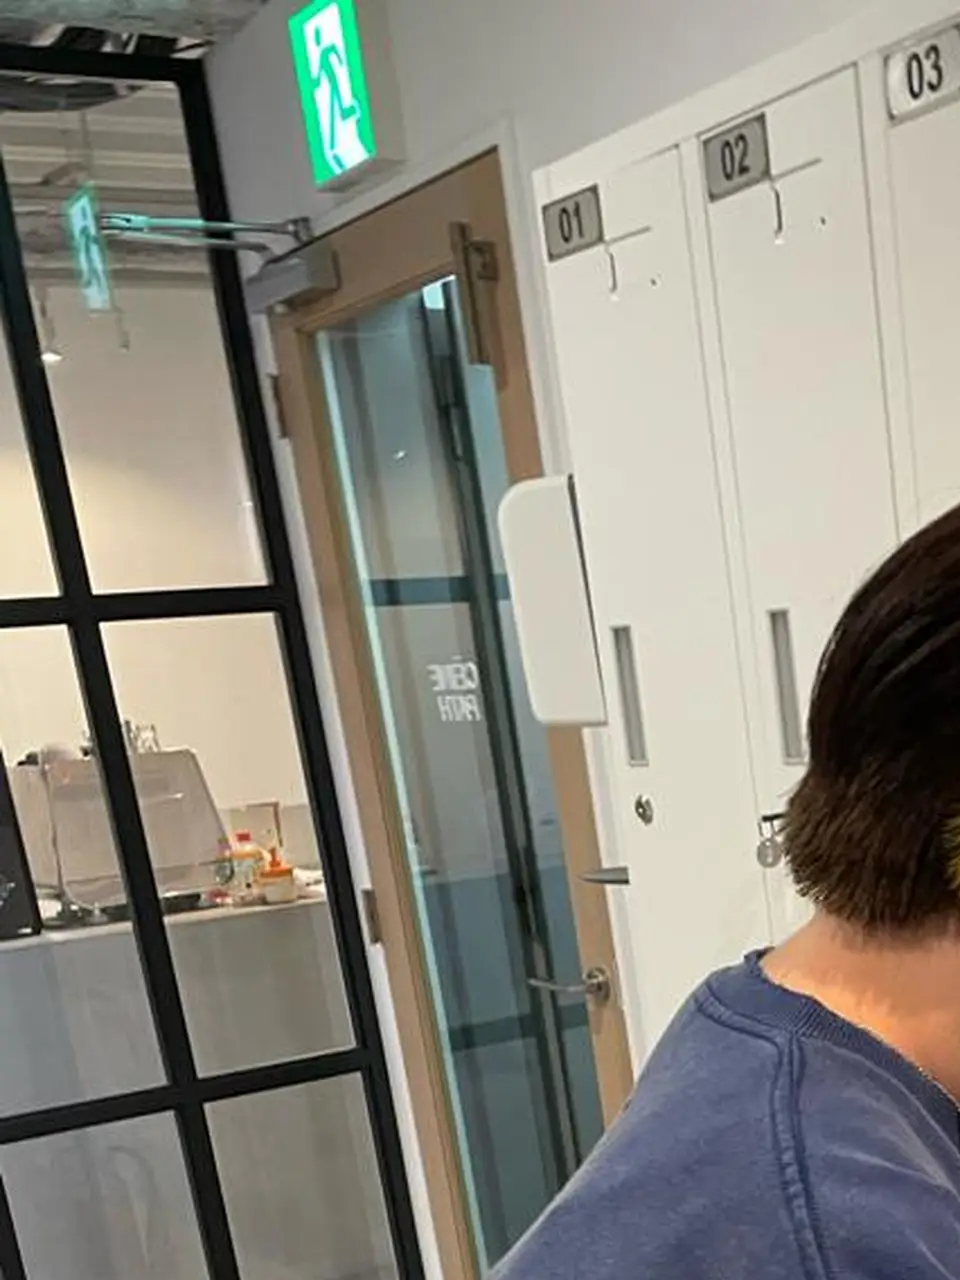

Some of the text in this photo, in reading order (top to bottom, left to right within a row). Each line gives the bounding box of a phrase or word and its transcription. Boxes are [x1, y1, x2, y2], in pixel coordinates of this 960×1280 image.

[906, 43, 943, 100] 03
[721, 134, 750, 181] 02
[559, 201, 584, 243] 01
